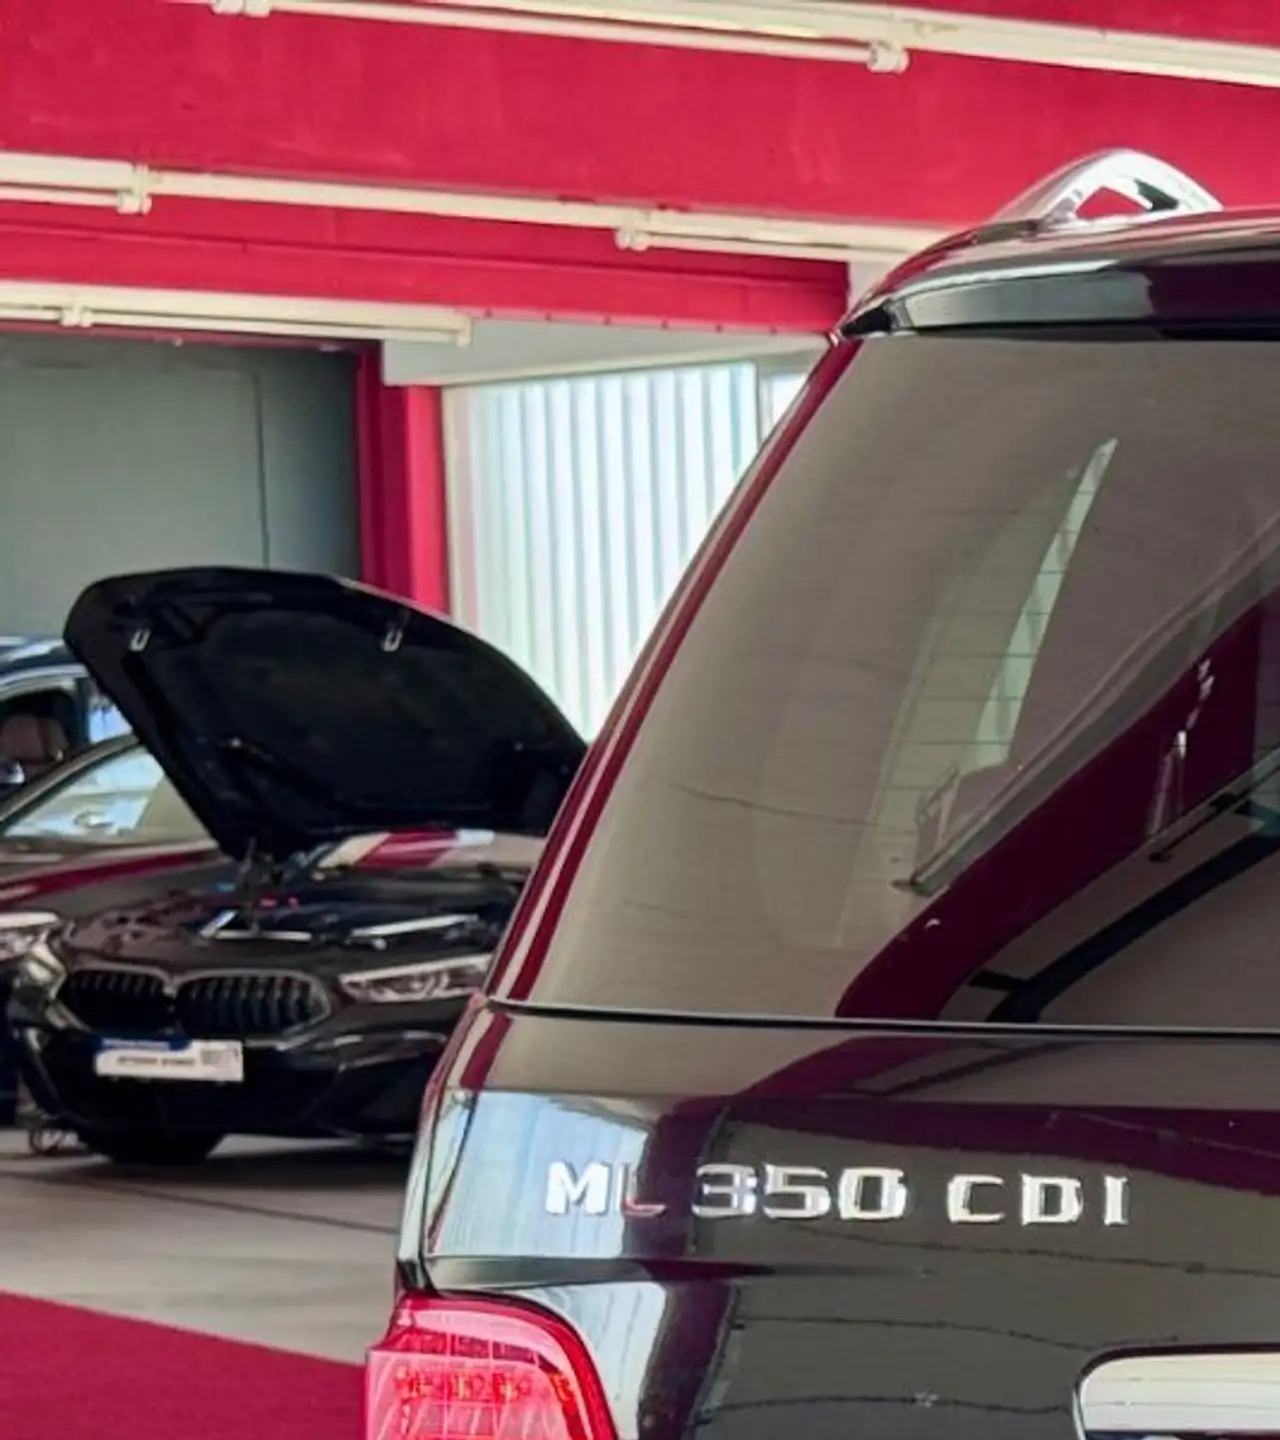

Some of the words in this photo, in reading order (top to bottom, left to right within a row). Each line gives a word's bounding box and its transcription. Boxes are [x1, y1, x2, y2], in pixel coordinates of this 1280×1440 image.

[544, 1161, 667, 1217] ML
[691, 1162, 909, 1221] 350
[945, 1172, 1131, 1227] CDI
